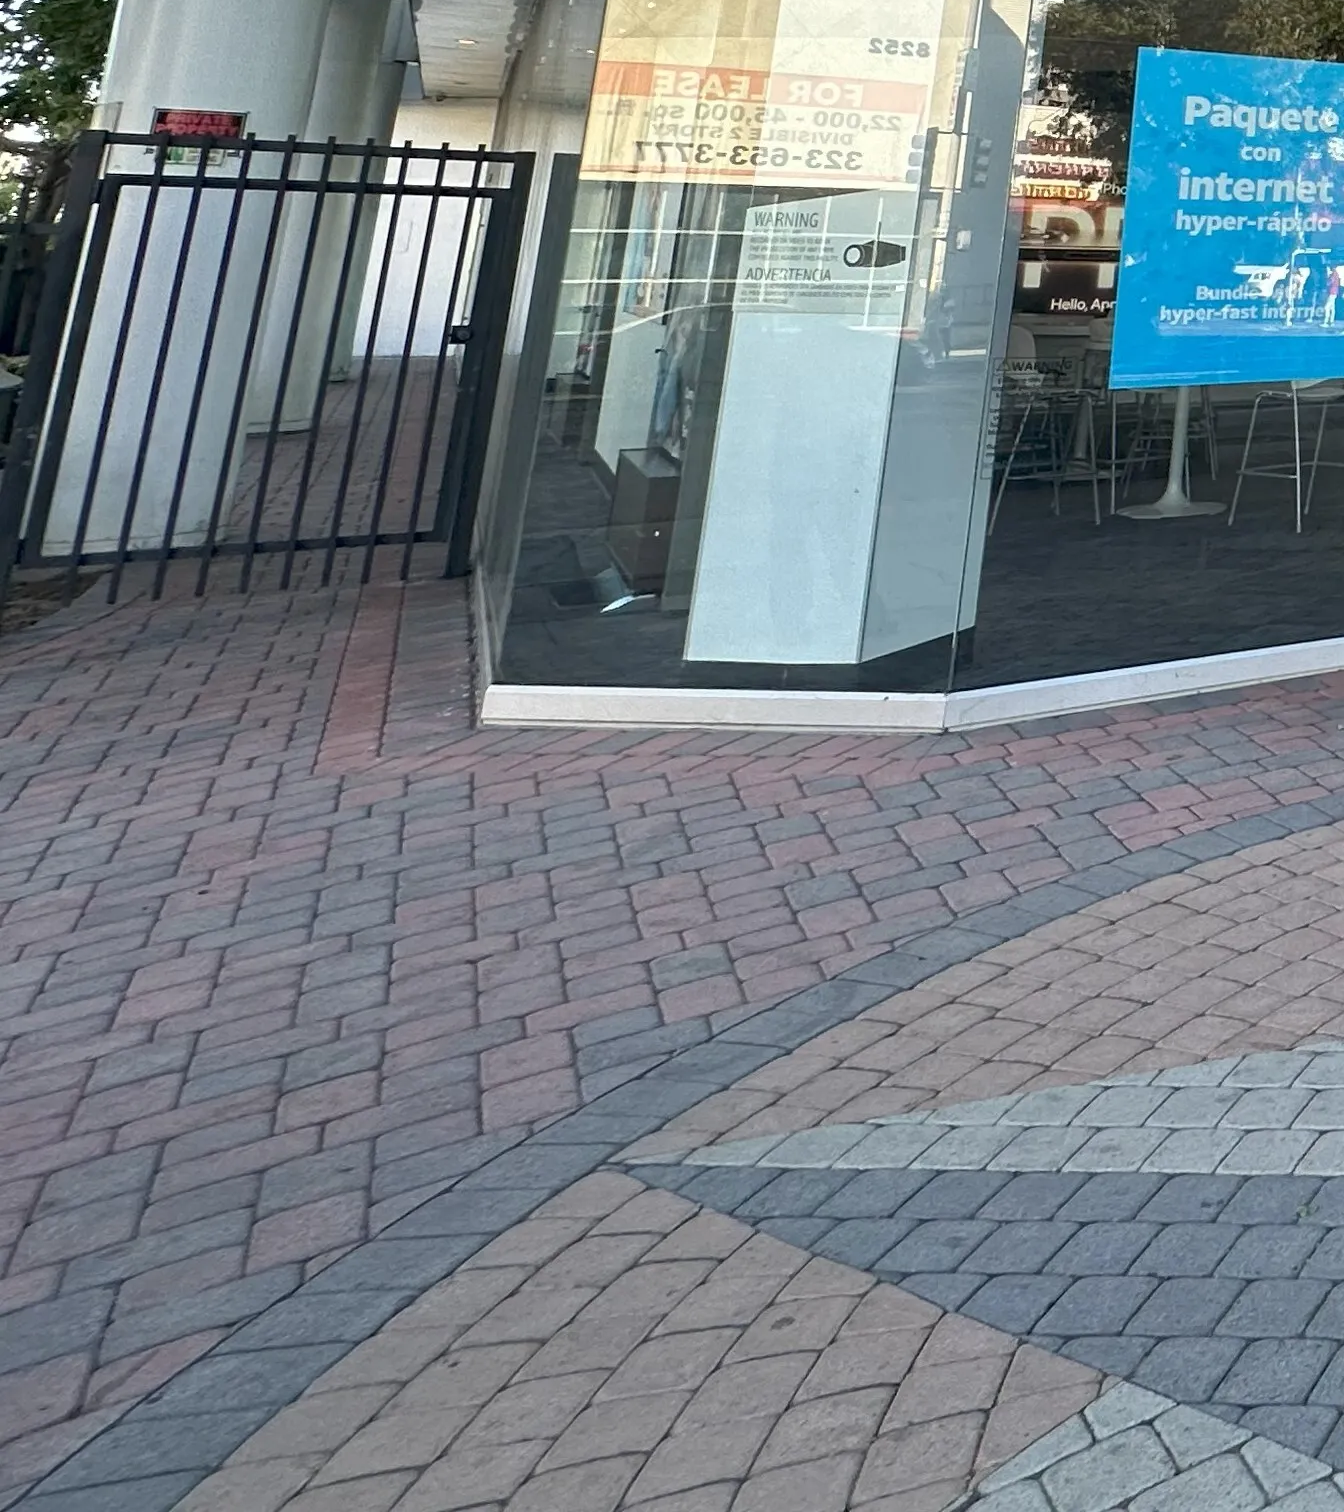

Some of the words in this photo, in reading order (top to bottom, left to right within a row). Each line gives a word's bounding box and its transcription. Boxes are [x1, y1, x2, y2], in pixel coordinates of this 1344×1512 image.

[1184, 96, 1339, 137] Paquete
[1240, 145, 1281, 161] con
[1179, 167, 1334, 204] internet
[755, 212, 819, 227] WARNING
[1176, 210, 1332, 236] hyper-rápido
[745, 268, 832, 282] ADVERTENCIA
[1050, 298, 1088, 312] Hello,
[1160, 304, 1257, 325] hyper-fast
[1261, 304, 1333, 321] interne
